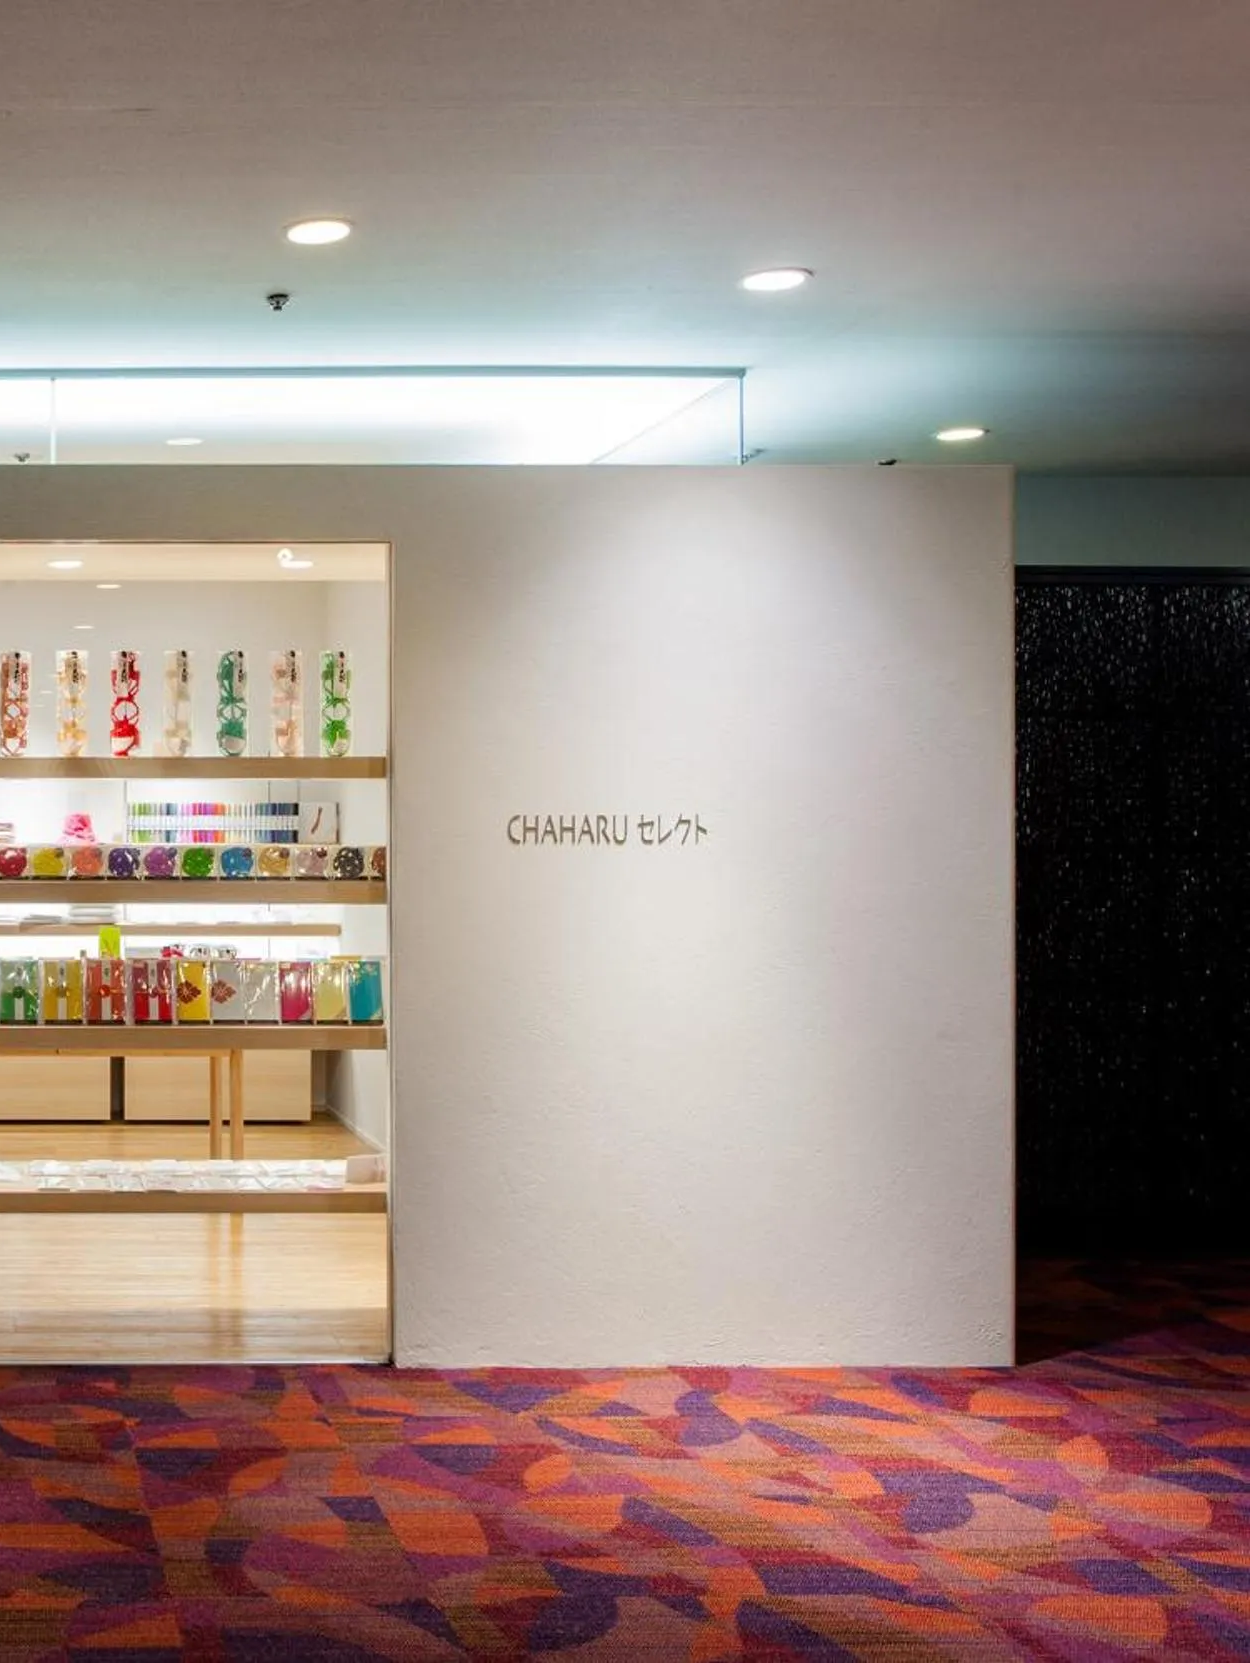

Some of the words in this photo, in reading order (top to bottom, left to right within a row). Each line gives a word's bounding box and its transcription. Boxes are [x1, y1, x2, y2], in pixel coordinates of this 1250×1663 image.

[507, 814, 628, 846] CHAHARU
[637, 813, 708, 846] セレクト
